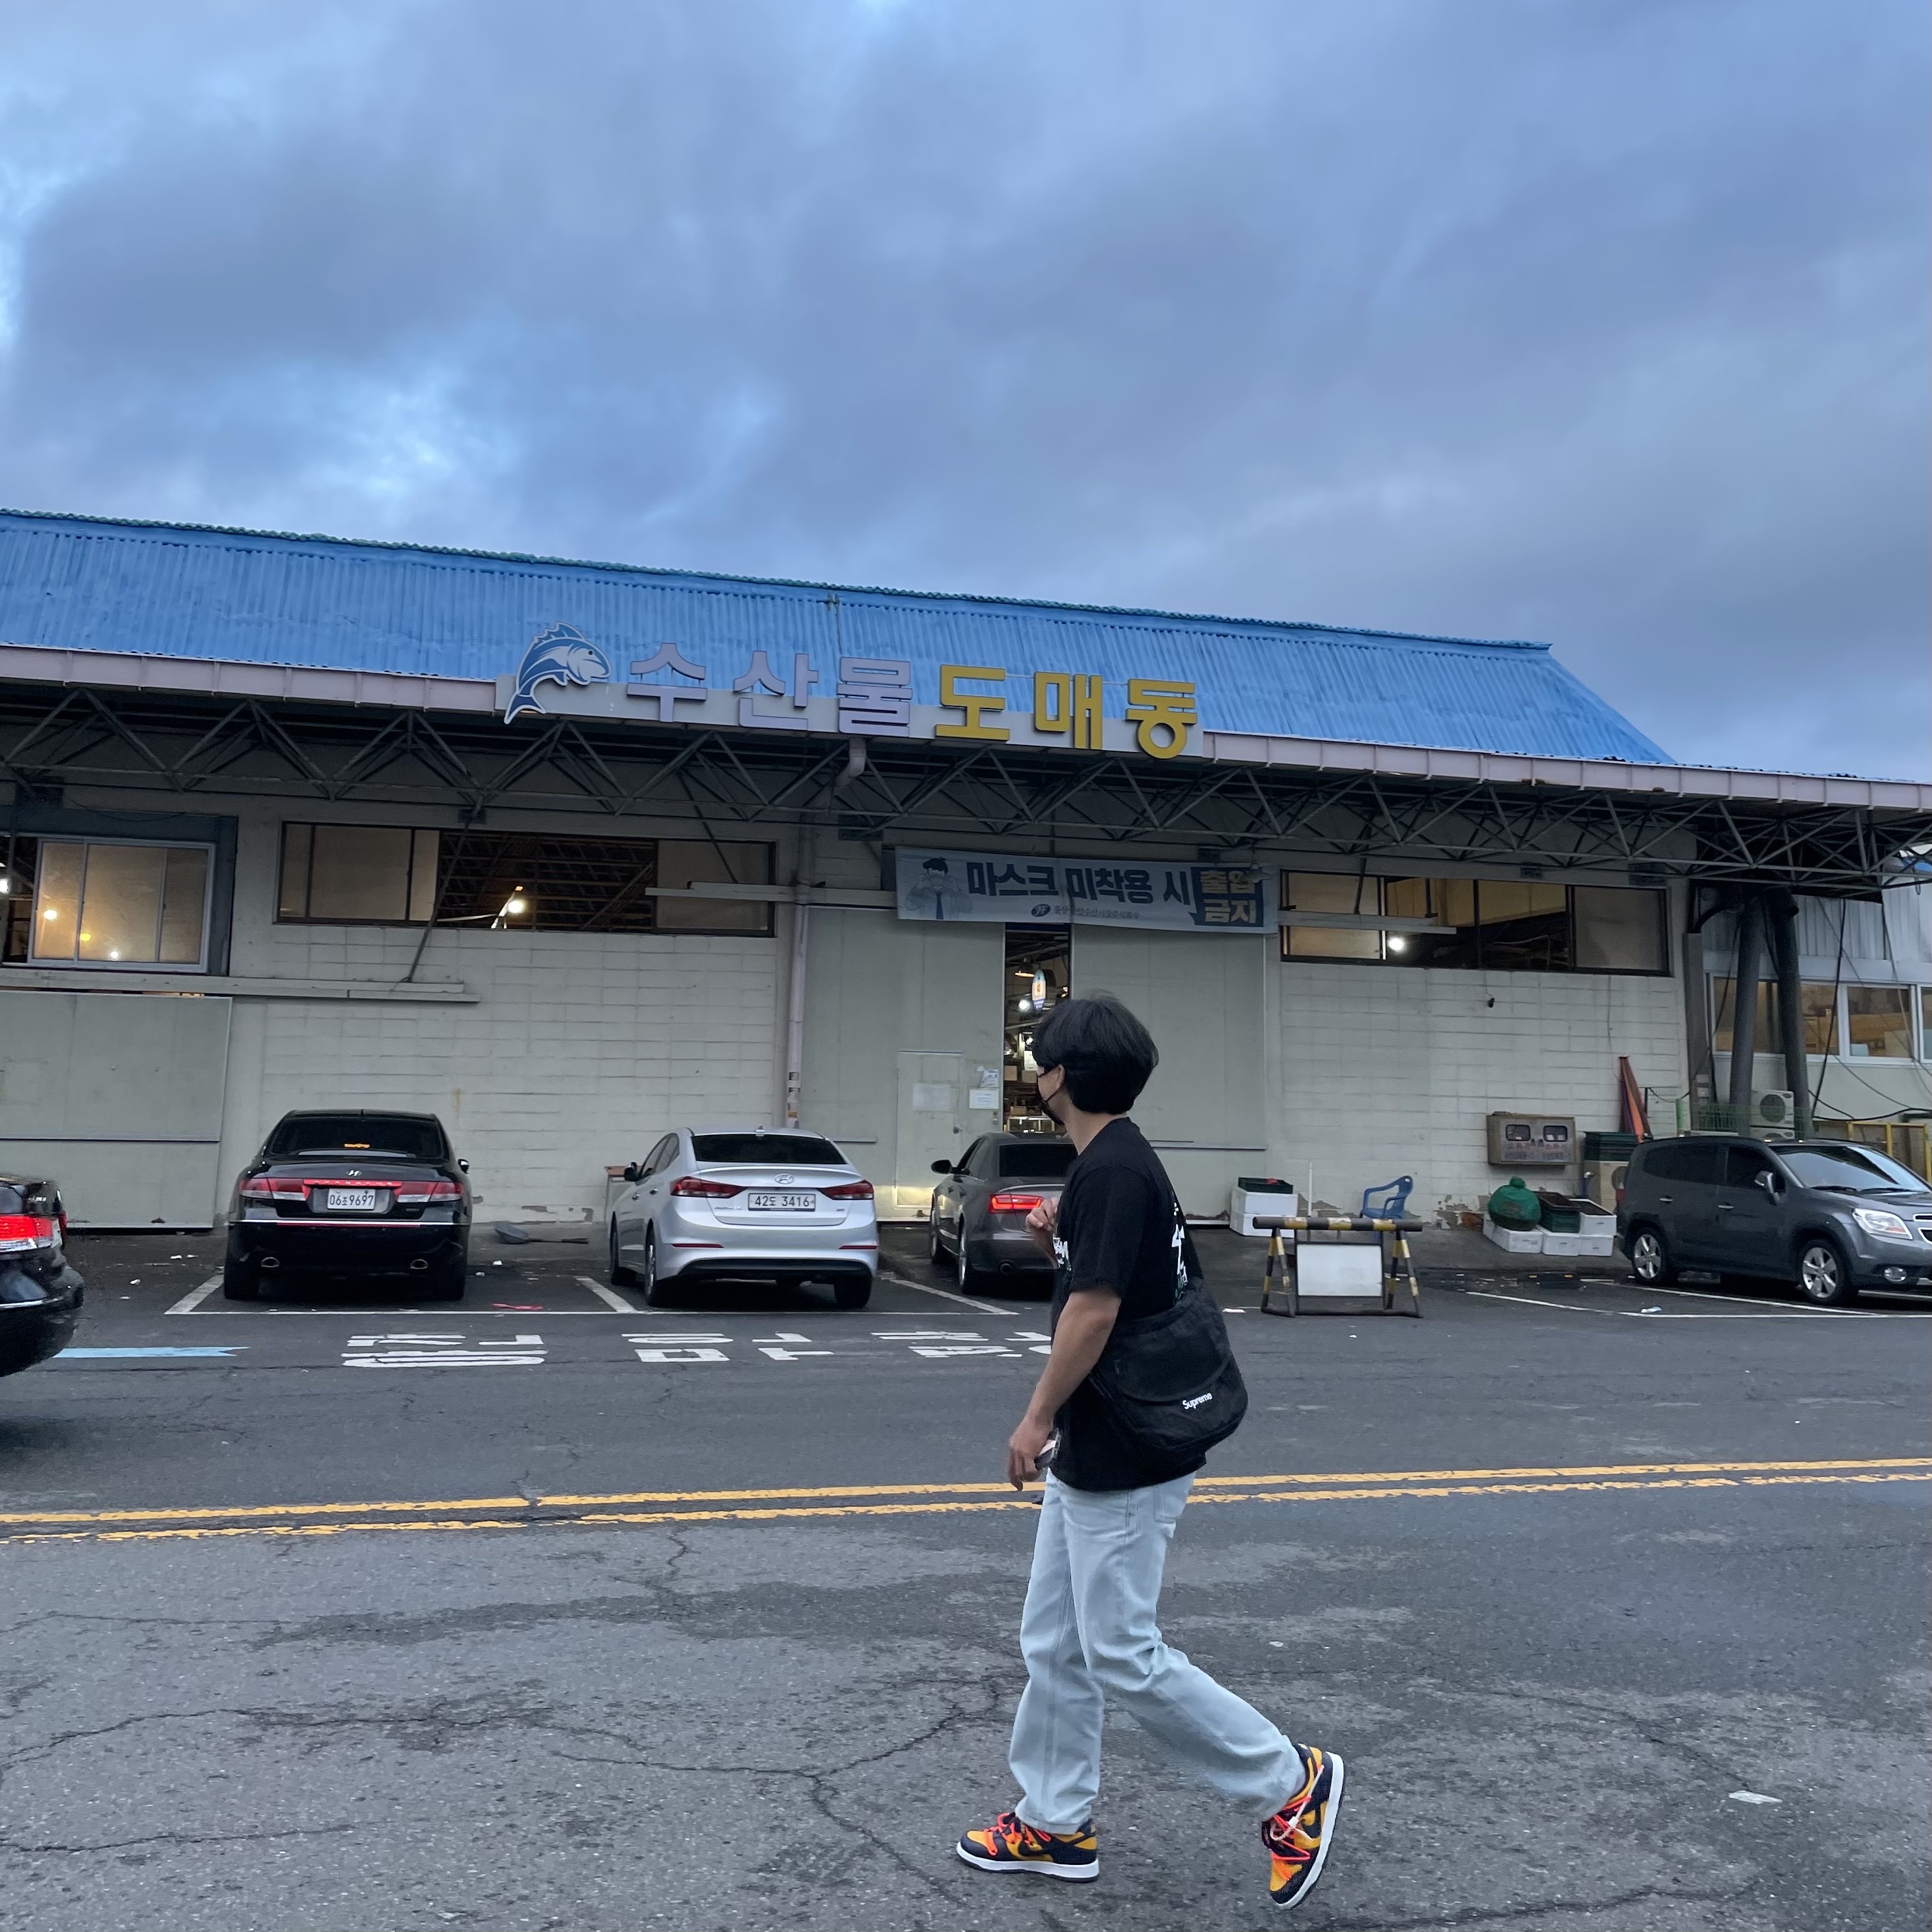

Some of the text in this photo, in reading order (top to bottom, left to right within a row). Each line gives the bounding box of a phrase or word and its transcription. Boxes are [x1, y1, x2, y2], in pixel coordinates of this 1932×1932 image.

[967, 861, 1190, 905] 마스크 미착용 시
[1200, 870, 1255, 894] 출입
[1203, 899, 1257, 924] 금지
[1182, 1393, 1212, 1410] Supreme
